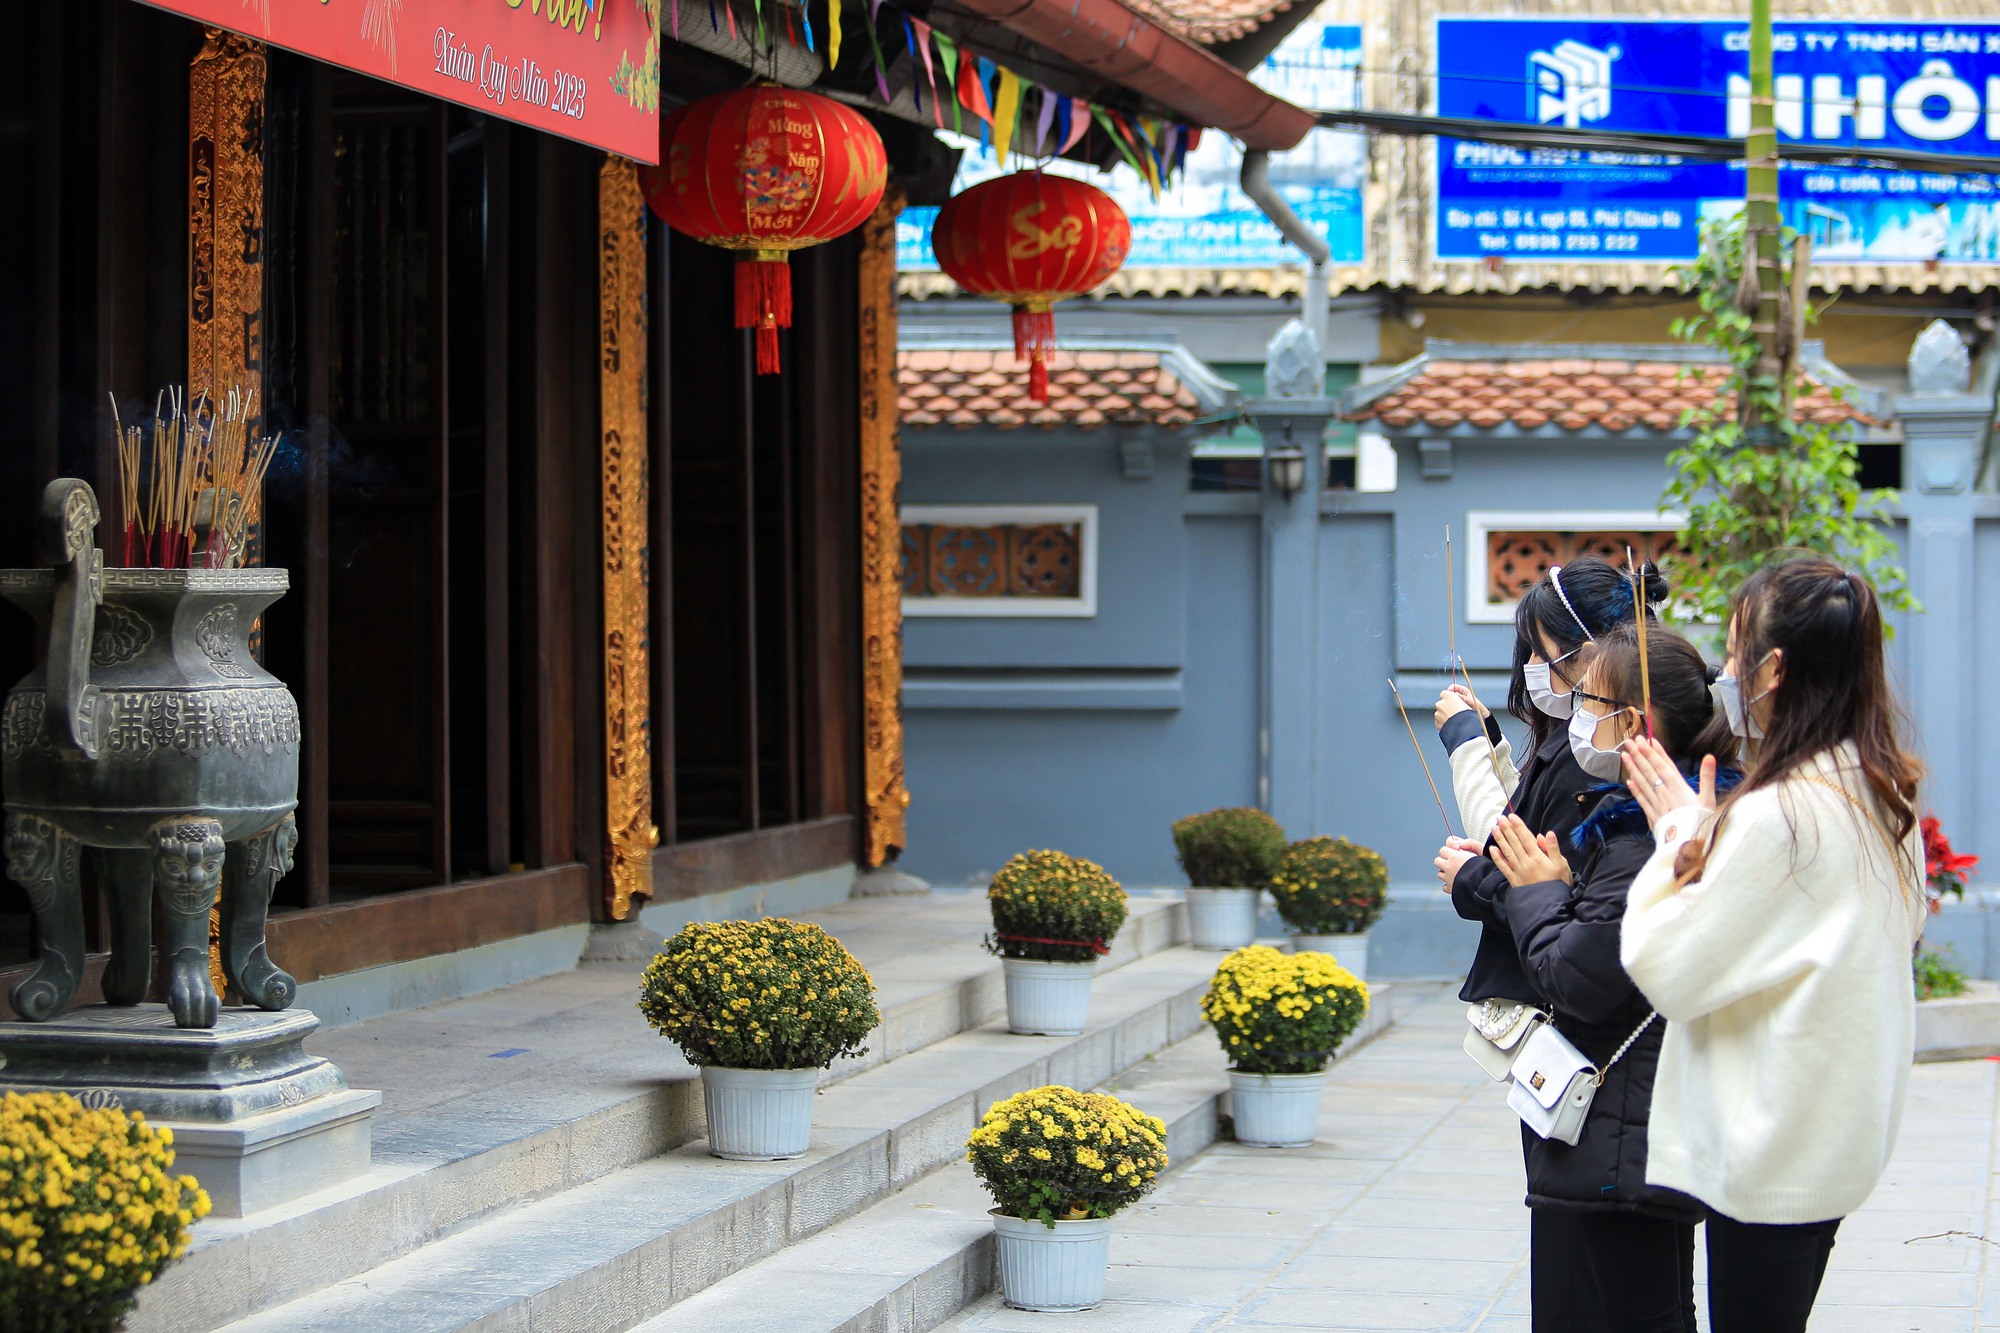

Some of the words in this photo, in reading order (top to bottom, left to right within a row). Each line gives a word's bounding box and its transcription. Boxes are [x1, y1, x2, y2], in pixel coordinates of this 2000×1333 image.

[1804, 33, 1838, 51] TY
[434, 27, 476, 83] Xuân
[478, 44, 509, 105] Quý
[510, 58, 549, 107] Mão
[551, 69, 587, 120] 2023
